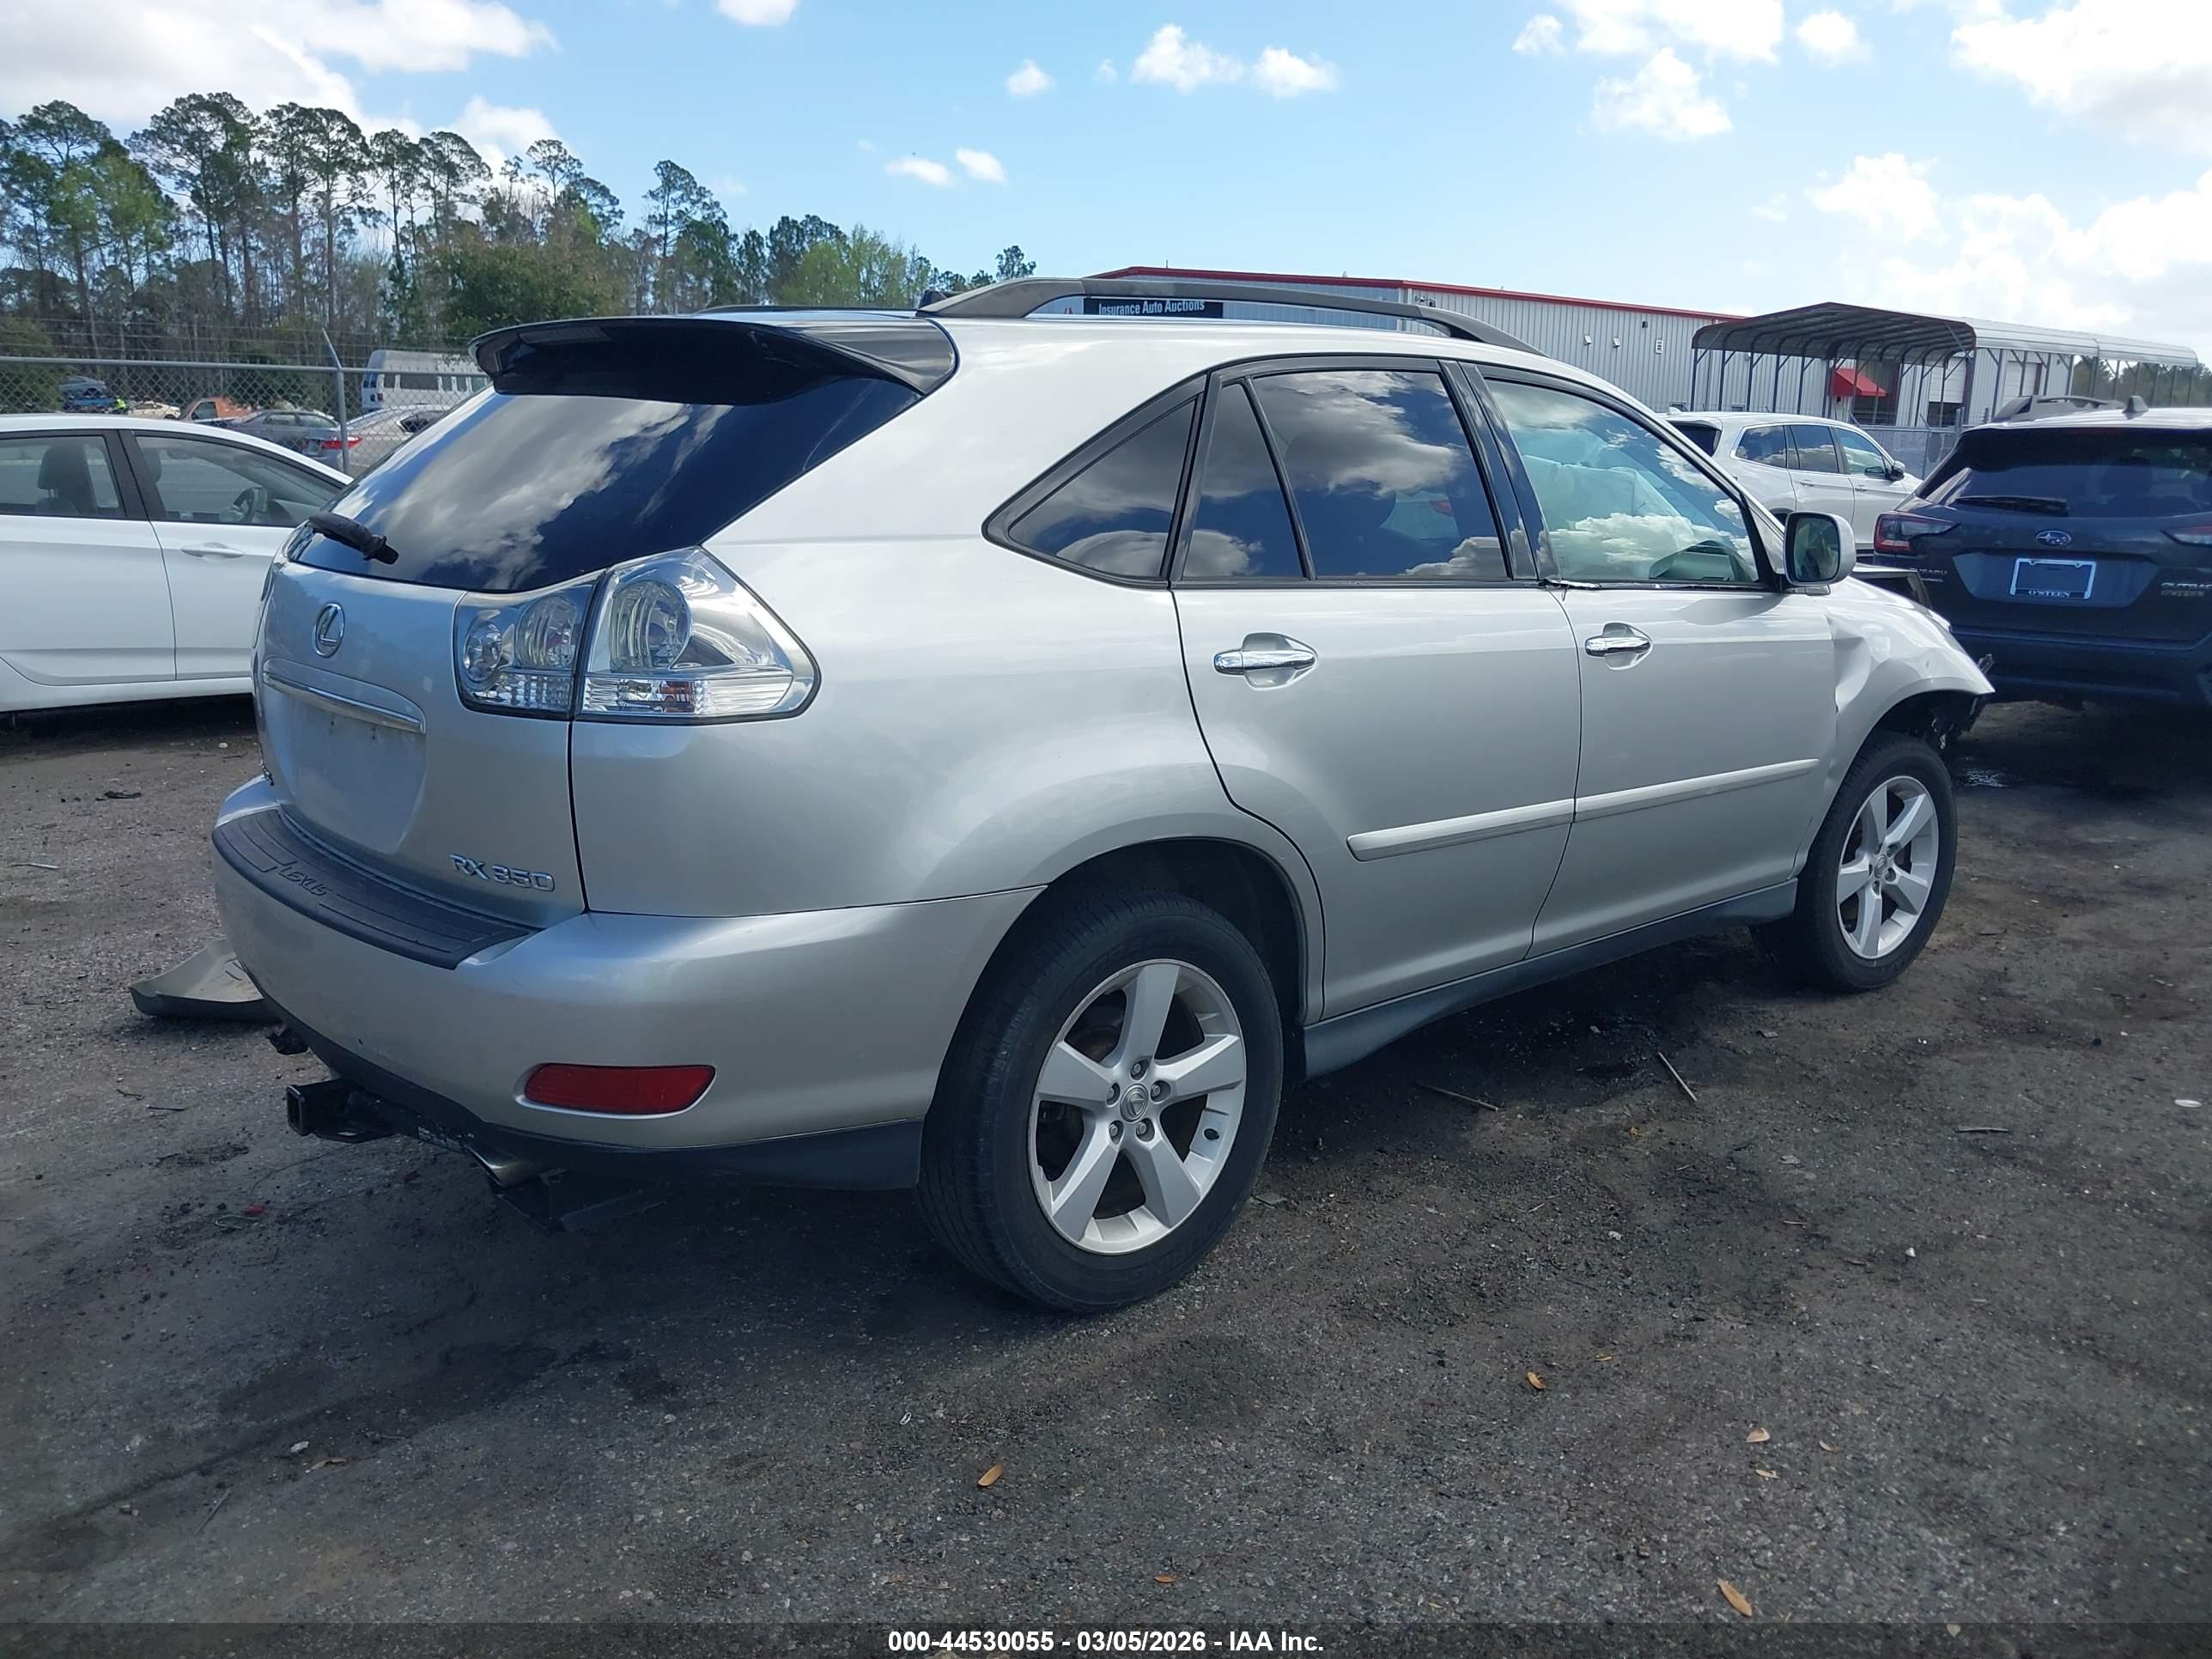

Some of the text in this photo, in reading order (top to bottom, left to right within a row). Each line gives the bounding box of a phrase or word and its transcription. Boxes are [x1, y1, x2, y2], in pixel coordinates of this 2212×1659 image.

[1098, 300, 1206, 315] Insurance Auto Auctions
[278, 866, 333, 896] LEXUS
[450, 853, 556, 892] RX 350
